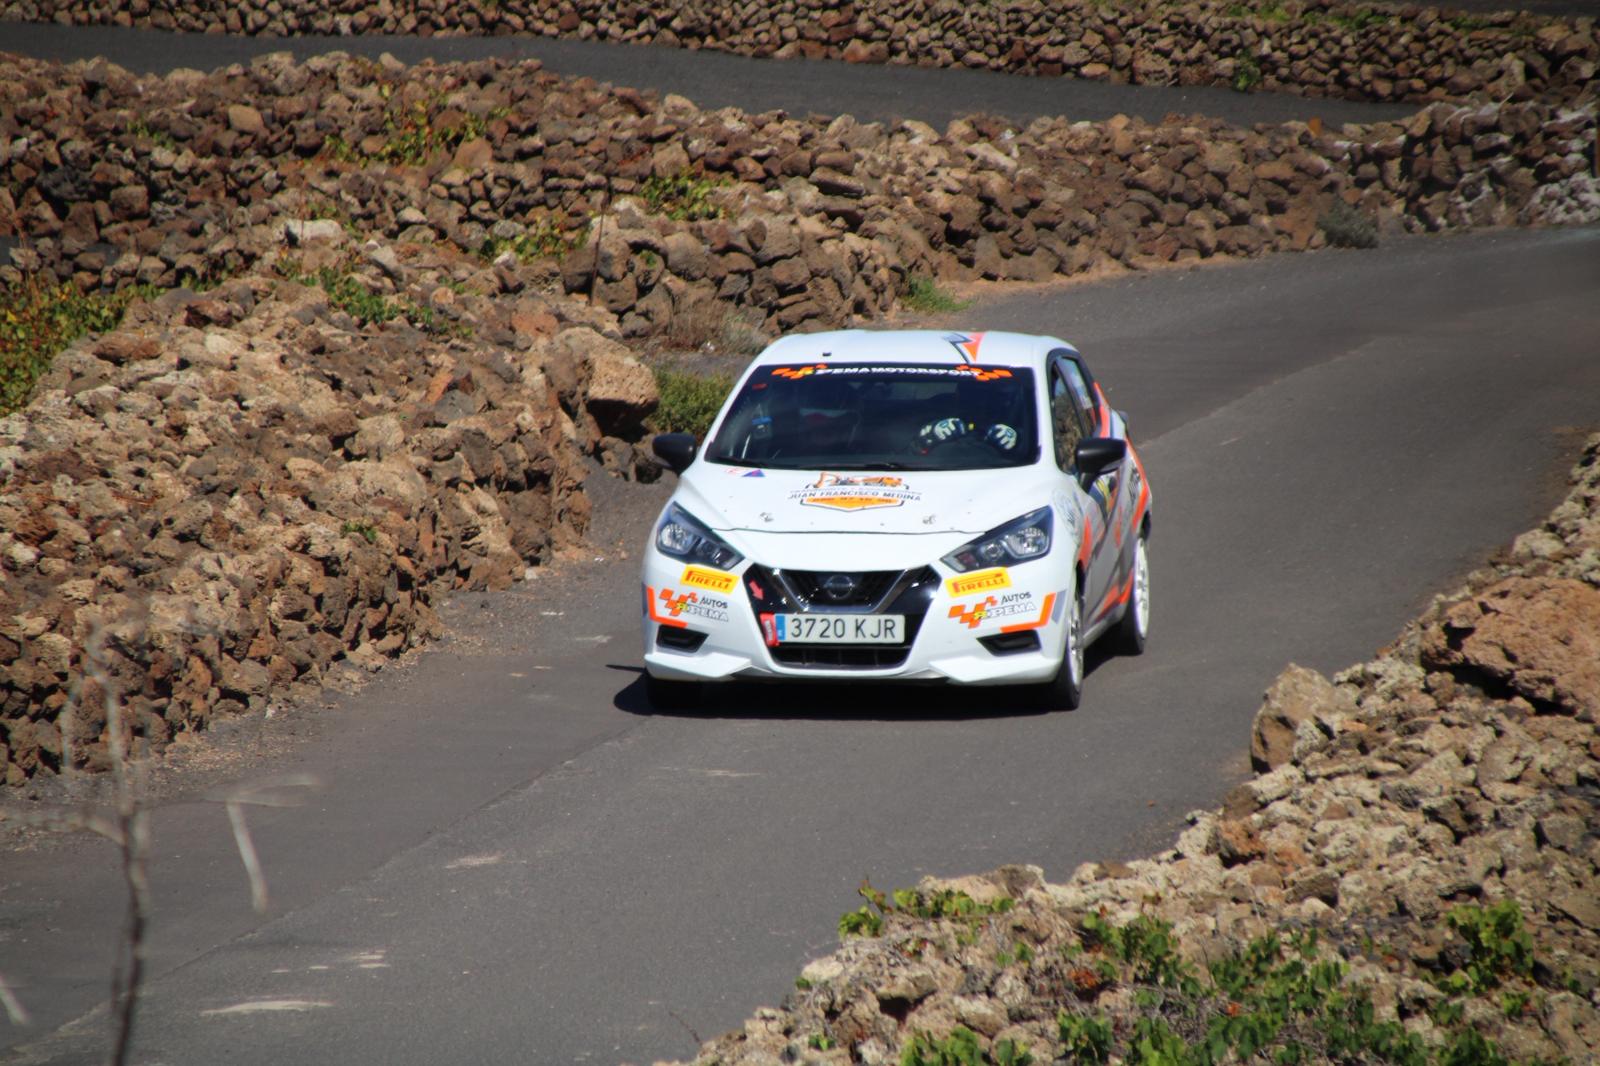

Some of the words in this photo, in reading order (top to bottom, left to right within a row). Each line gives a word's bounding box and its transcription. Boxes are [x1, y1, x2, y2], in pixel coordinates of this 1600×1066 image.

[788, 491, 817, 501] JUAN
[820, 490, 879, 498] FRANCISCO
[882, 491, 921, 501] MEDINA
[686, 570, 732, 589] PIRELLI
[952, 573, 1005, 593] PIRELLI
[700, 596, 728, 608] AUTOS
[1001, 592, 1031, 604] AUTOS
[791, 618, 846, 638] 3720
[855, 619, 896, 638] KJR
